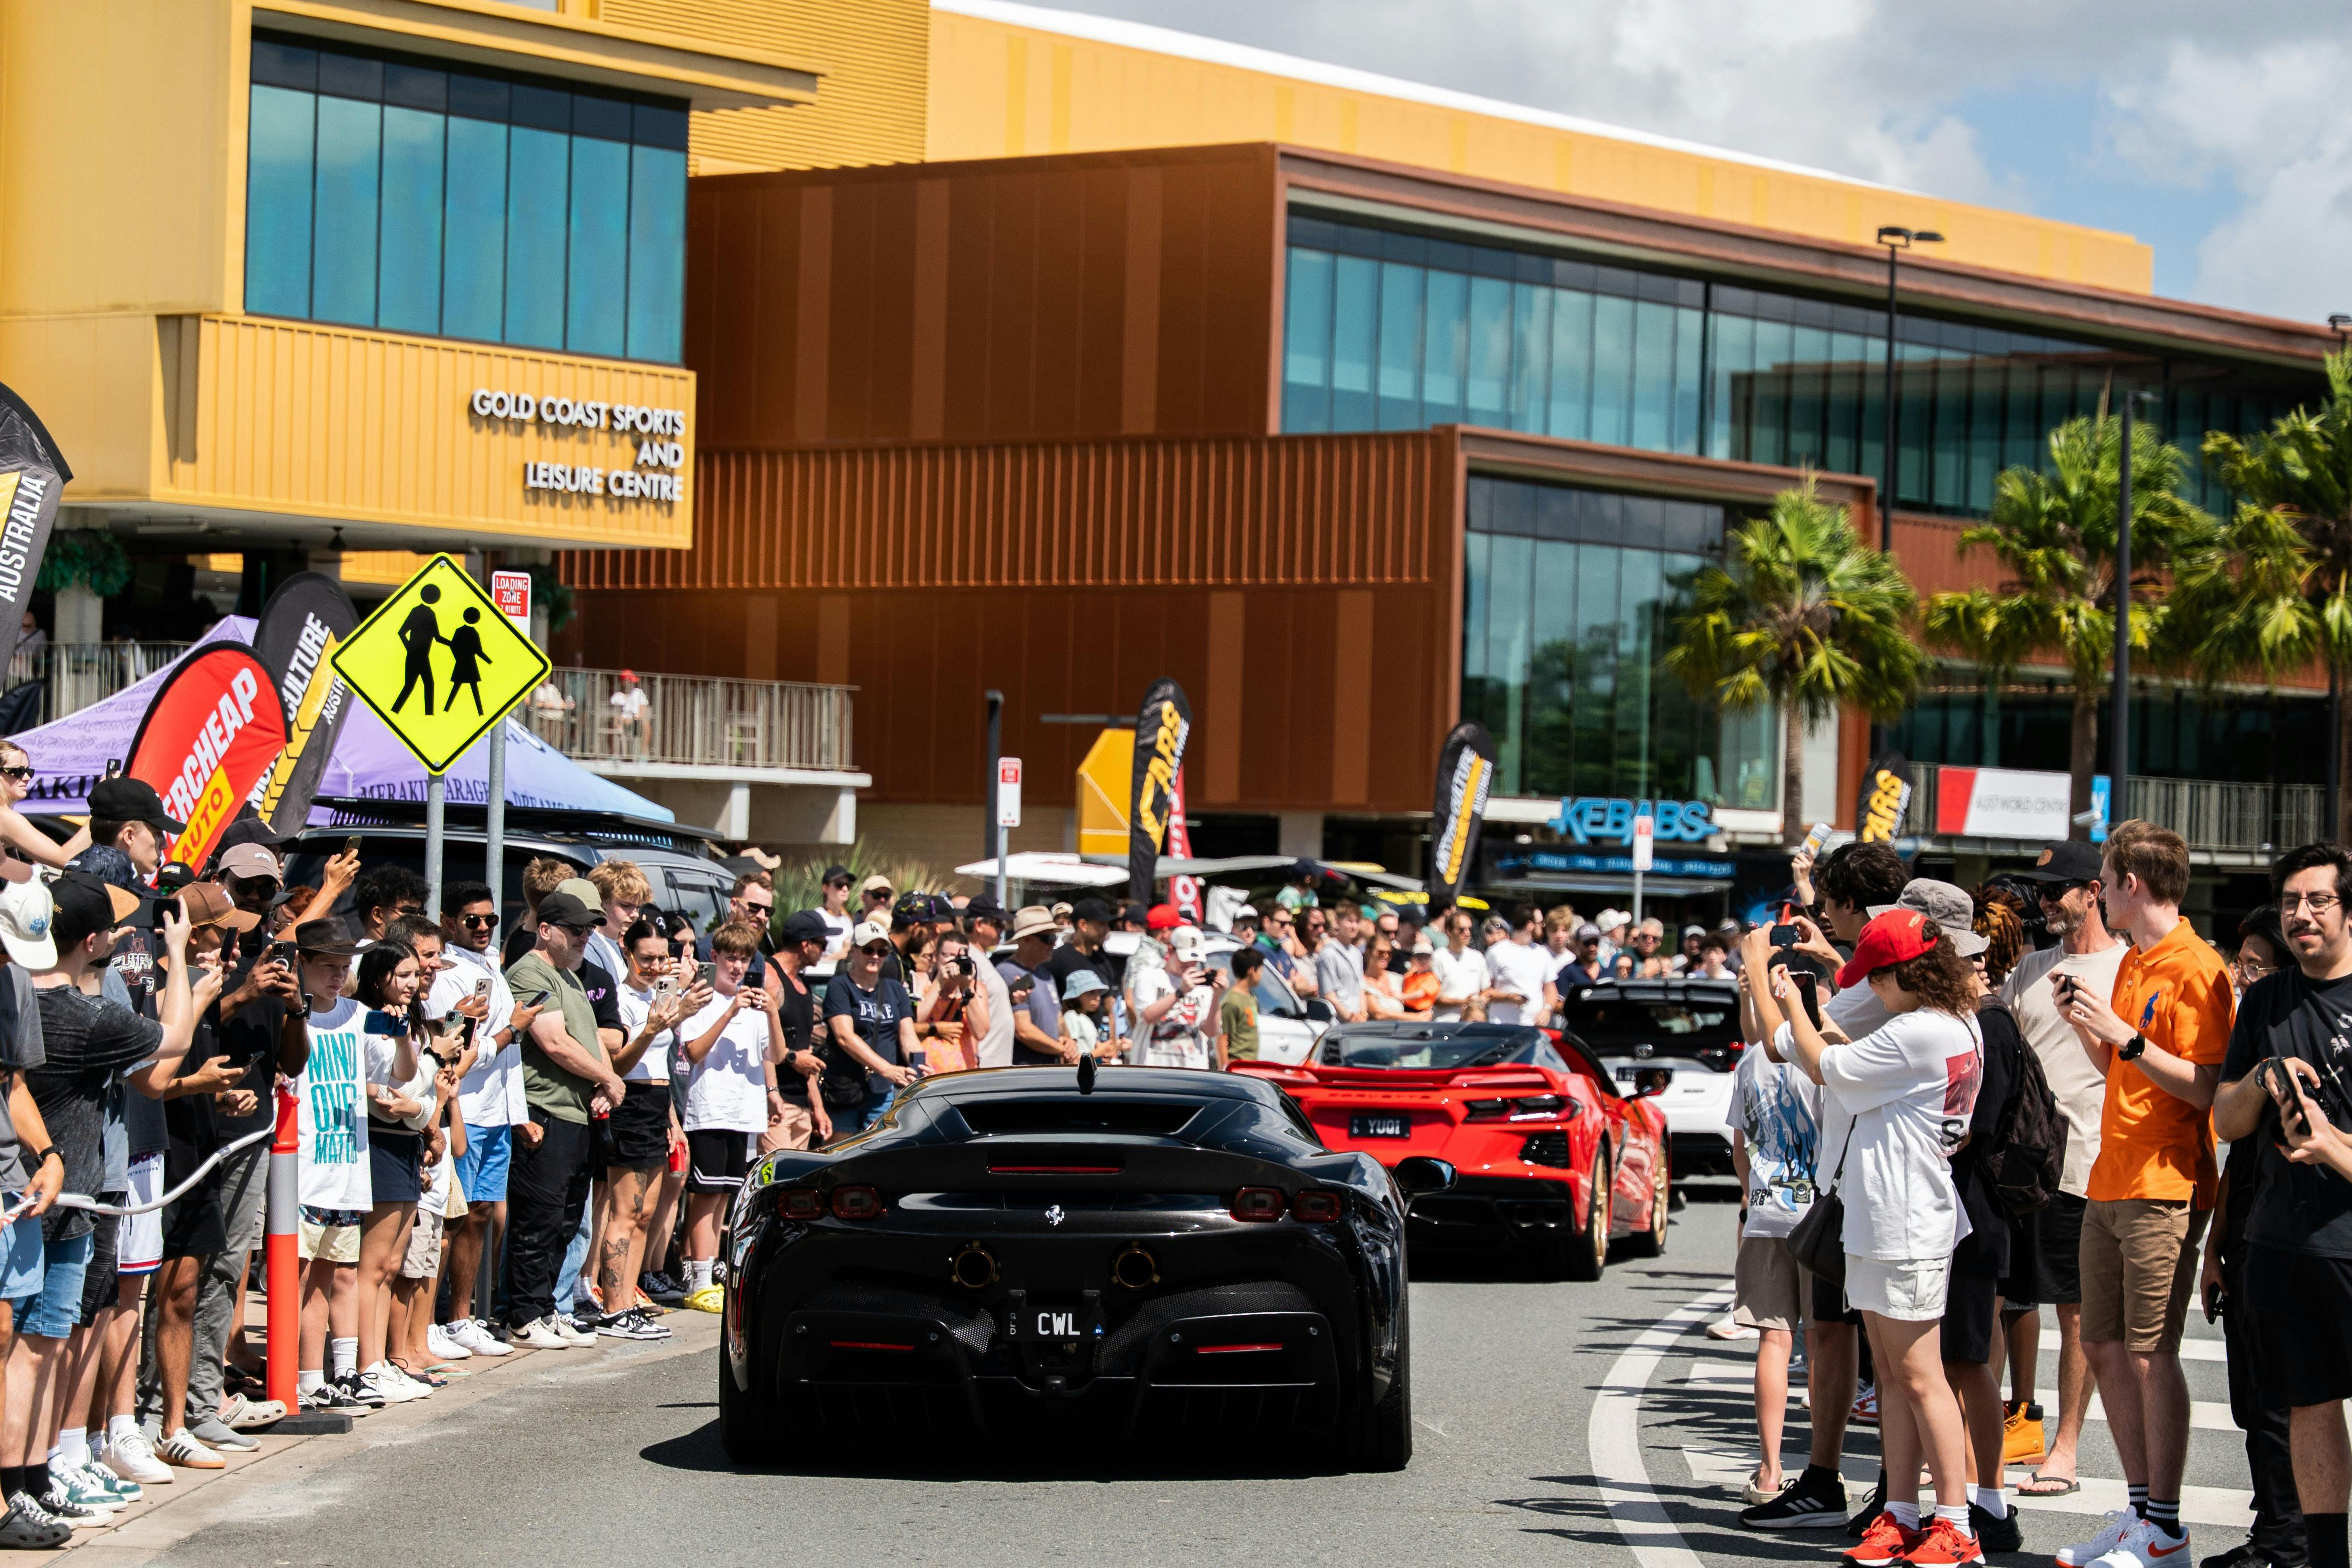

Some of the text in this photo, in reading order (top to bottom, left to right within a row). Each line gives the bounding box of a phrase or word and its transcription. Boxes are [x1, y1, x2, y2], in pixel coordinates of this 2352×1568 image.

[472, 389, 686, 436] GOLD COAST SPORTS
[637, 441, 684, 468] AND
[526, 461, 684, 502] LEISURE CENTRE
[0, 476, 47, 603] AUSTRALIA
[496, 577, 527, 591] LOADING
[502, 591, 522, 604] ZONE
[505, 605, 522, 614] MINUTE
[321, 671, 346, 725] AUSTR
[159, 667, 258, 846] ERCHEAP
[445, 778, 489, 802] ARAGE
[182, 786, 223, 862] AUTO
[308, 1032, 357, 1083] MIND
[1038, 1313, 1080, 1335] CWL
